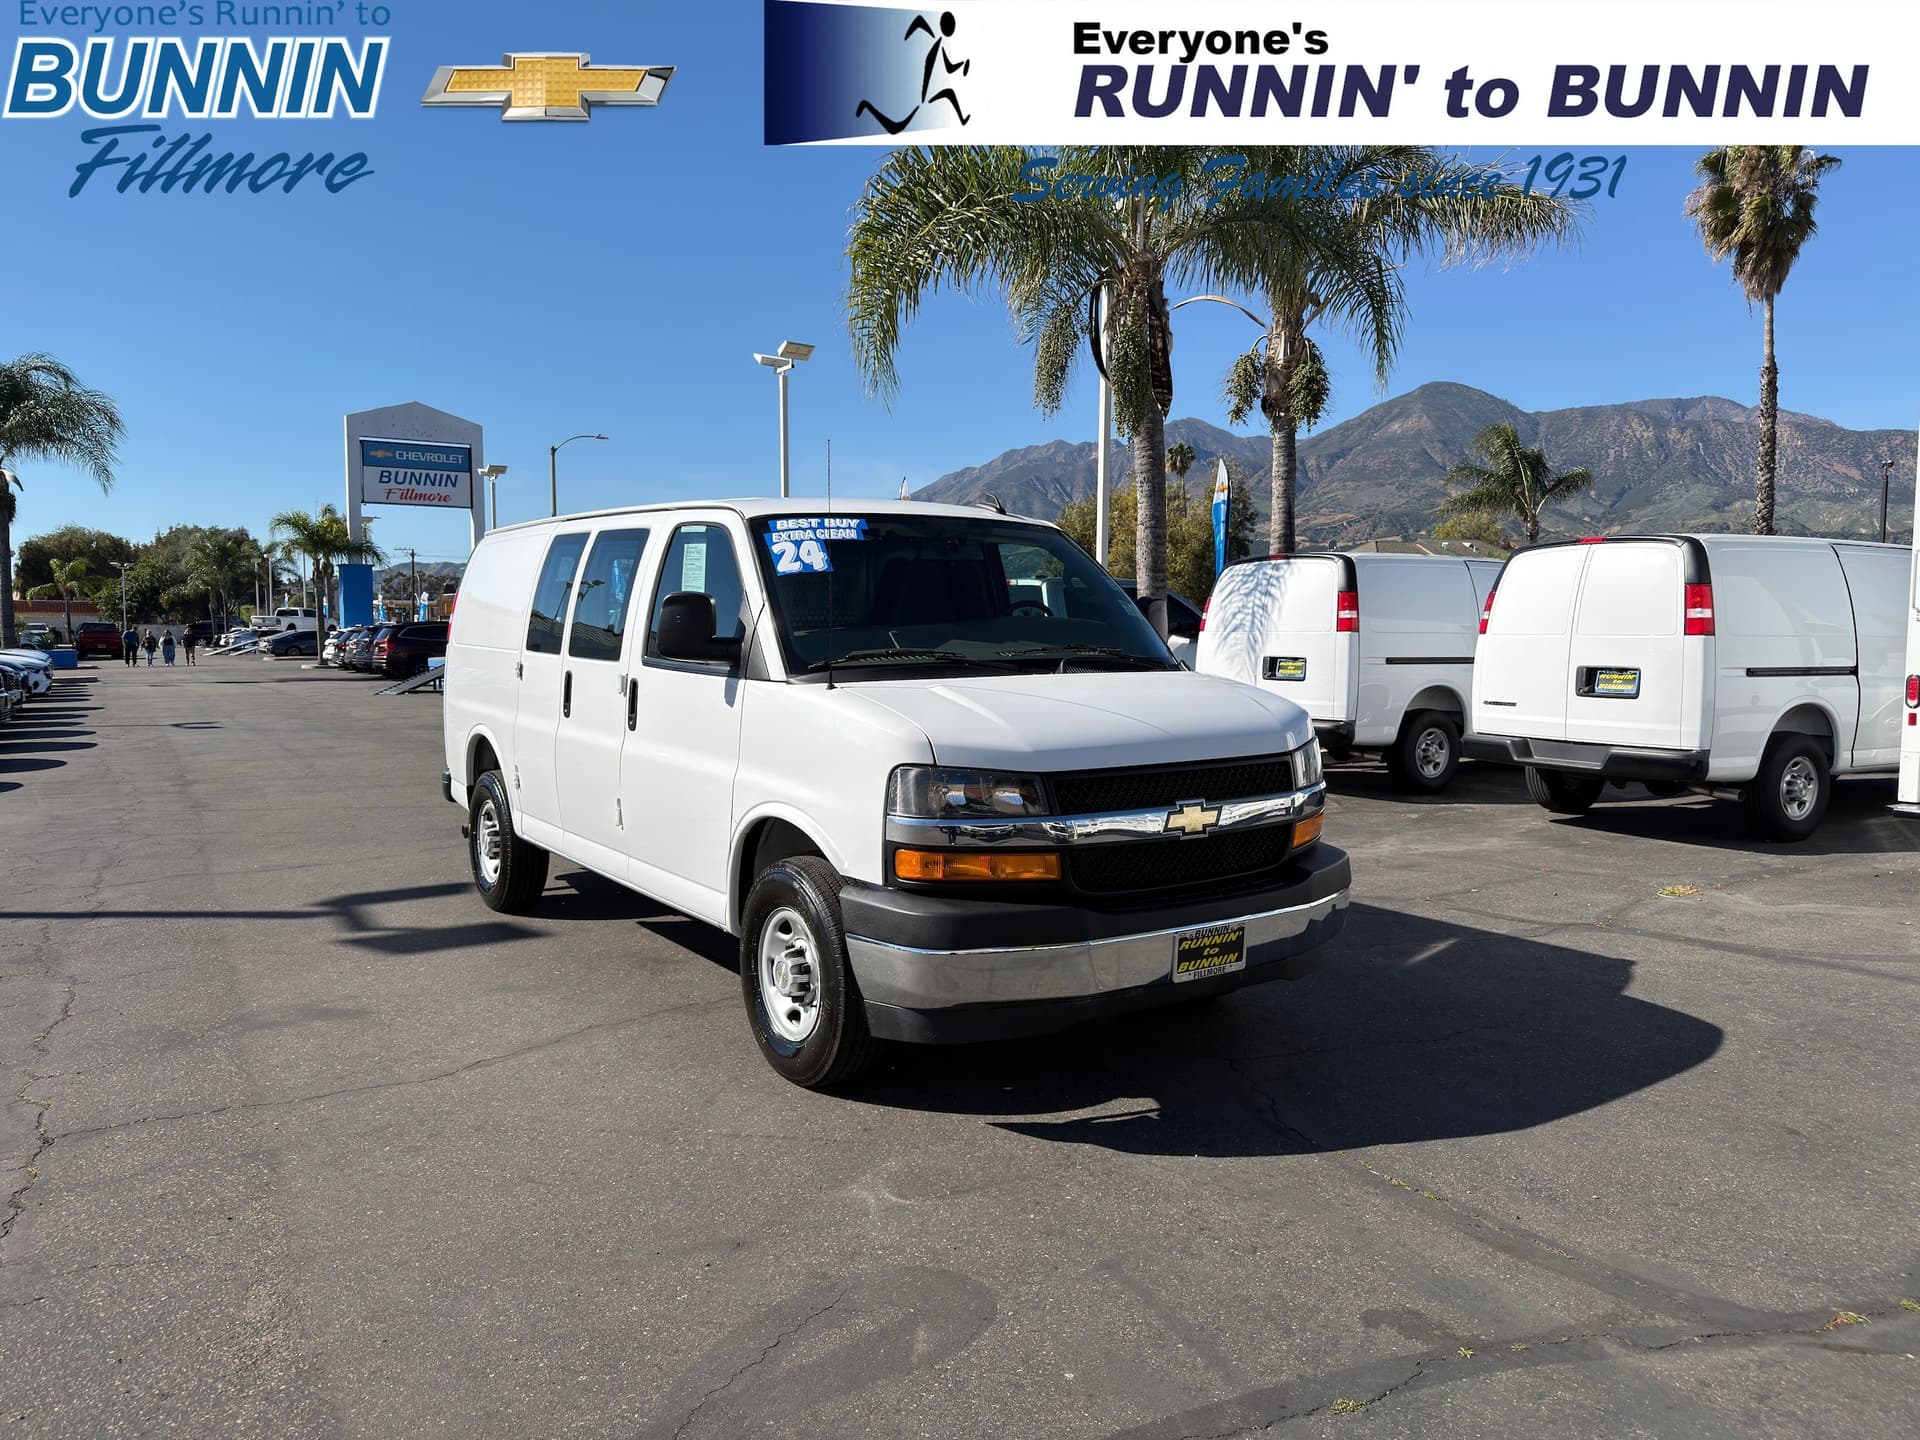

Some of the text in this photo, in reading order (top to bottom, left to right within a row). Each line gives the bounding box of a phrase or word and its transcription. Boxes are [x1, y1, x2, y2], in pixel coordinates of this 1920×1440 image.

[395, 450, 465, 464] CHEVROLET
[378, 470, 459, 488] BUNNIN
[384, 487, 452, 503] Fillmore
[776, 518, 860, 530] BEST BUY
[772, 529, 857, 542] EXTRA CLEAN
[771, 540, 828, 573] 24
[1194, 925, 1230, 938] BUNNIN
[1179, 931, 1243, 951] RUNNIN'
[1203, 947, 1220, 956] to
[1178, 953, 1239, 973] BUNNIN
[1193, 966, 1227, 978] FILLMORE
